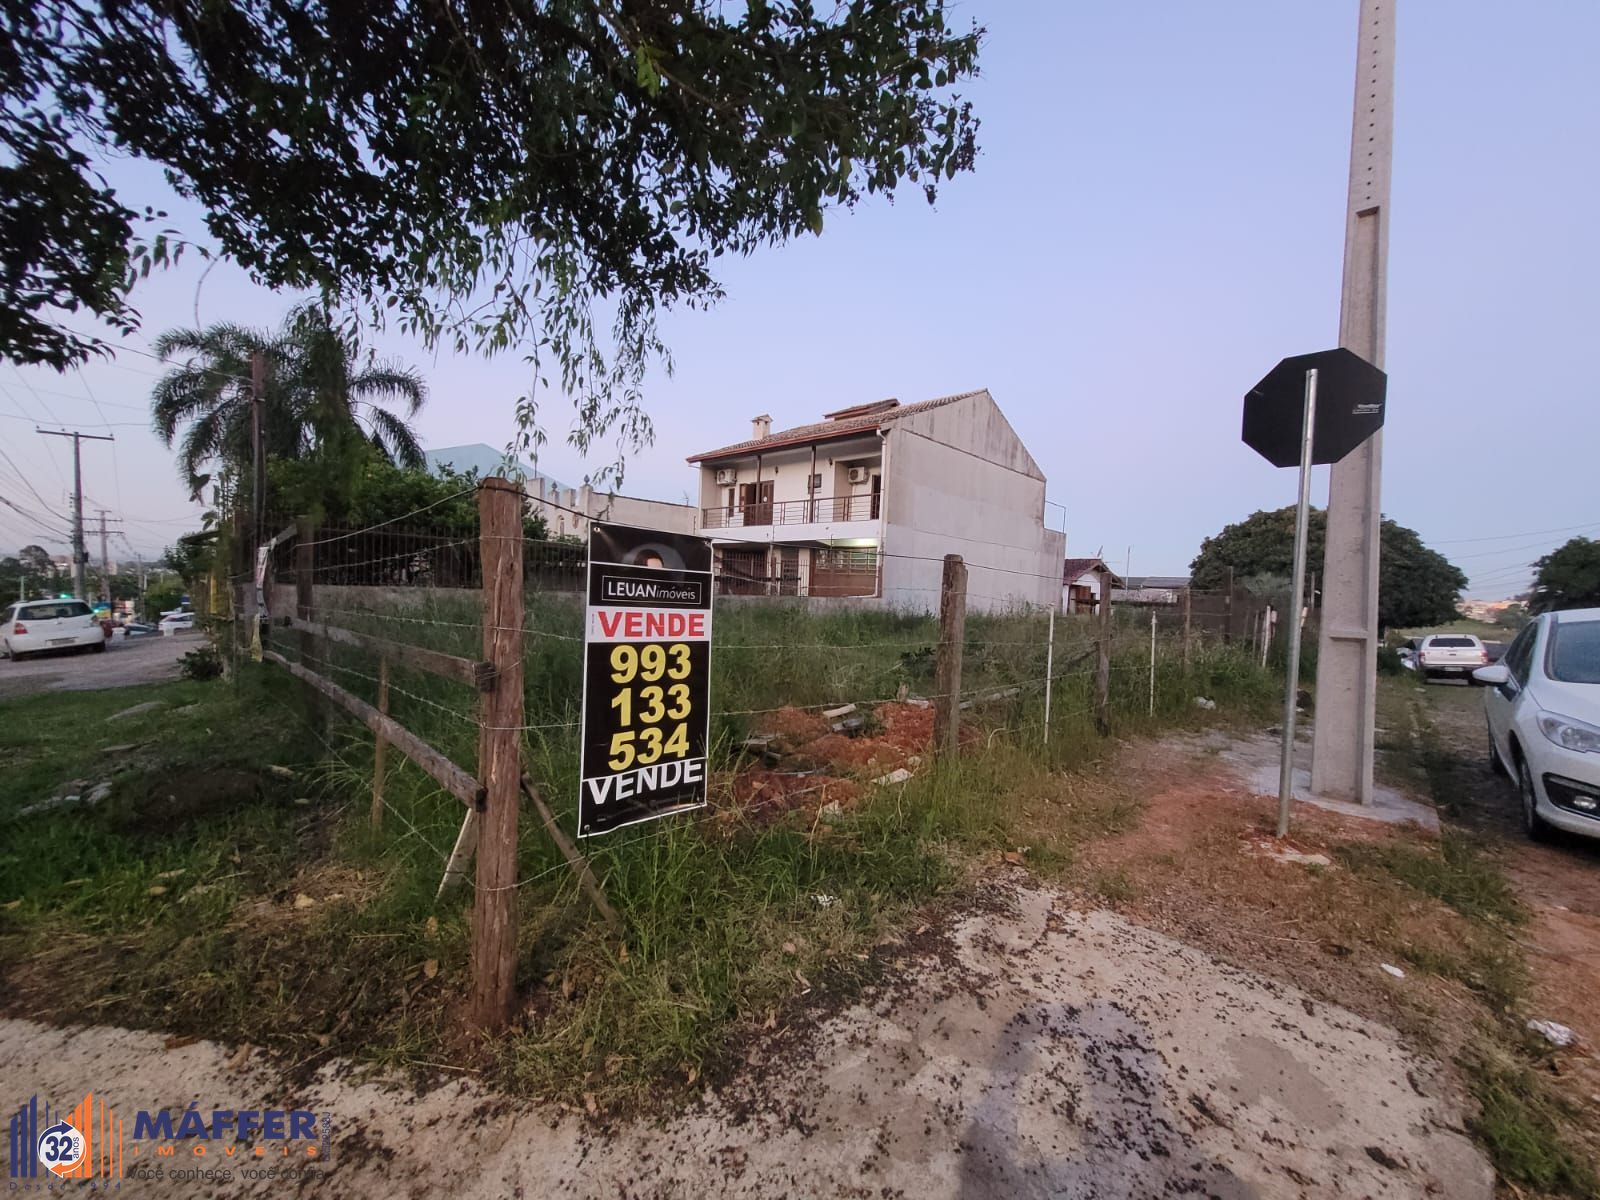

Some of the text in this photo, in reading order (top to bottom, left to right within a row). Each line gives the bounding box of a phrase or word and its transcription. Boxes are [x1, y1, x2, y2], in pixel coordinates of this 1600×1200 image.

[598, 611, 704, 637] VENDE
[610, 644, 692, 683] 993
[611, 684, 692, 726] 133
[608, 723, 689, 771] 534
[588, 759, 702, 805] VENDE
